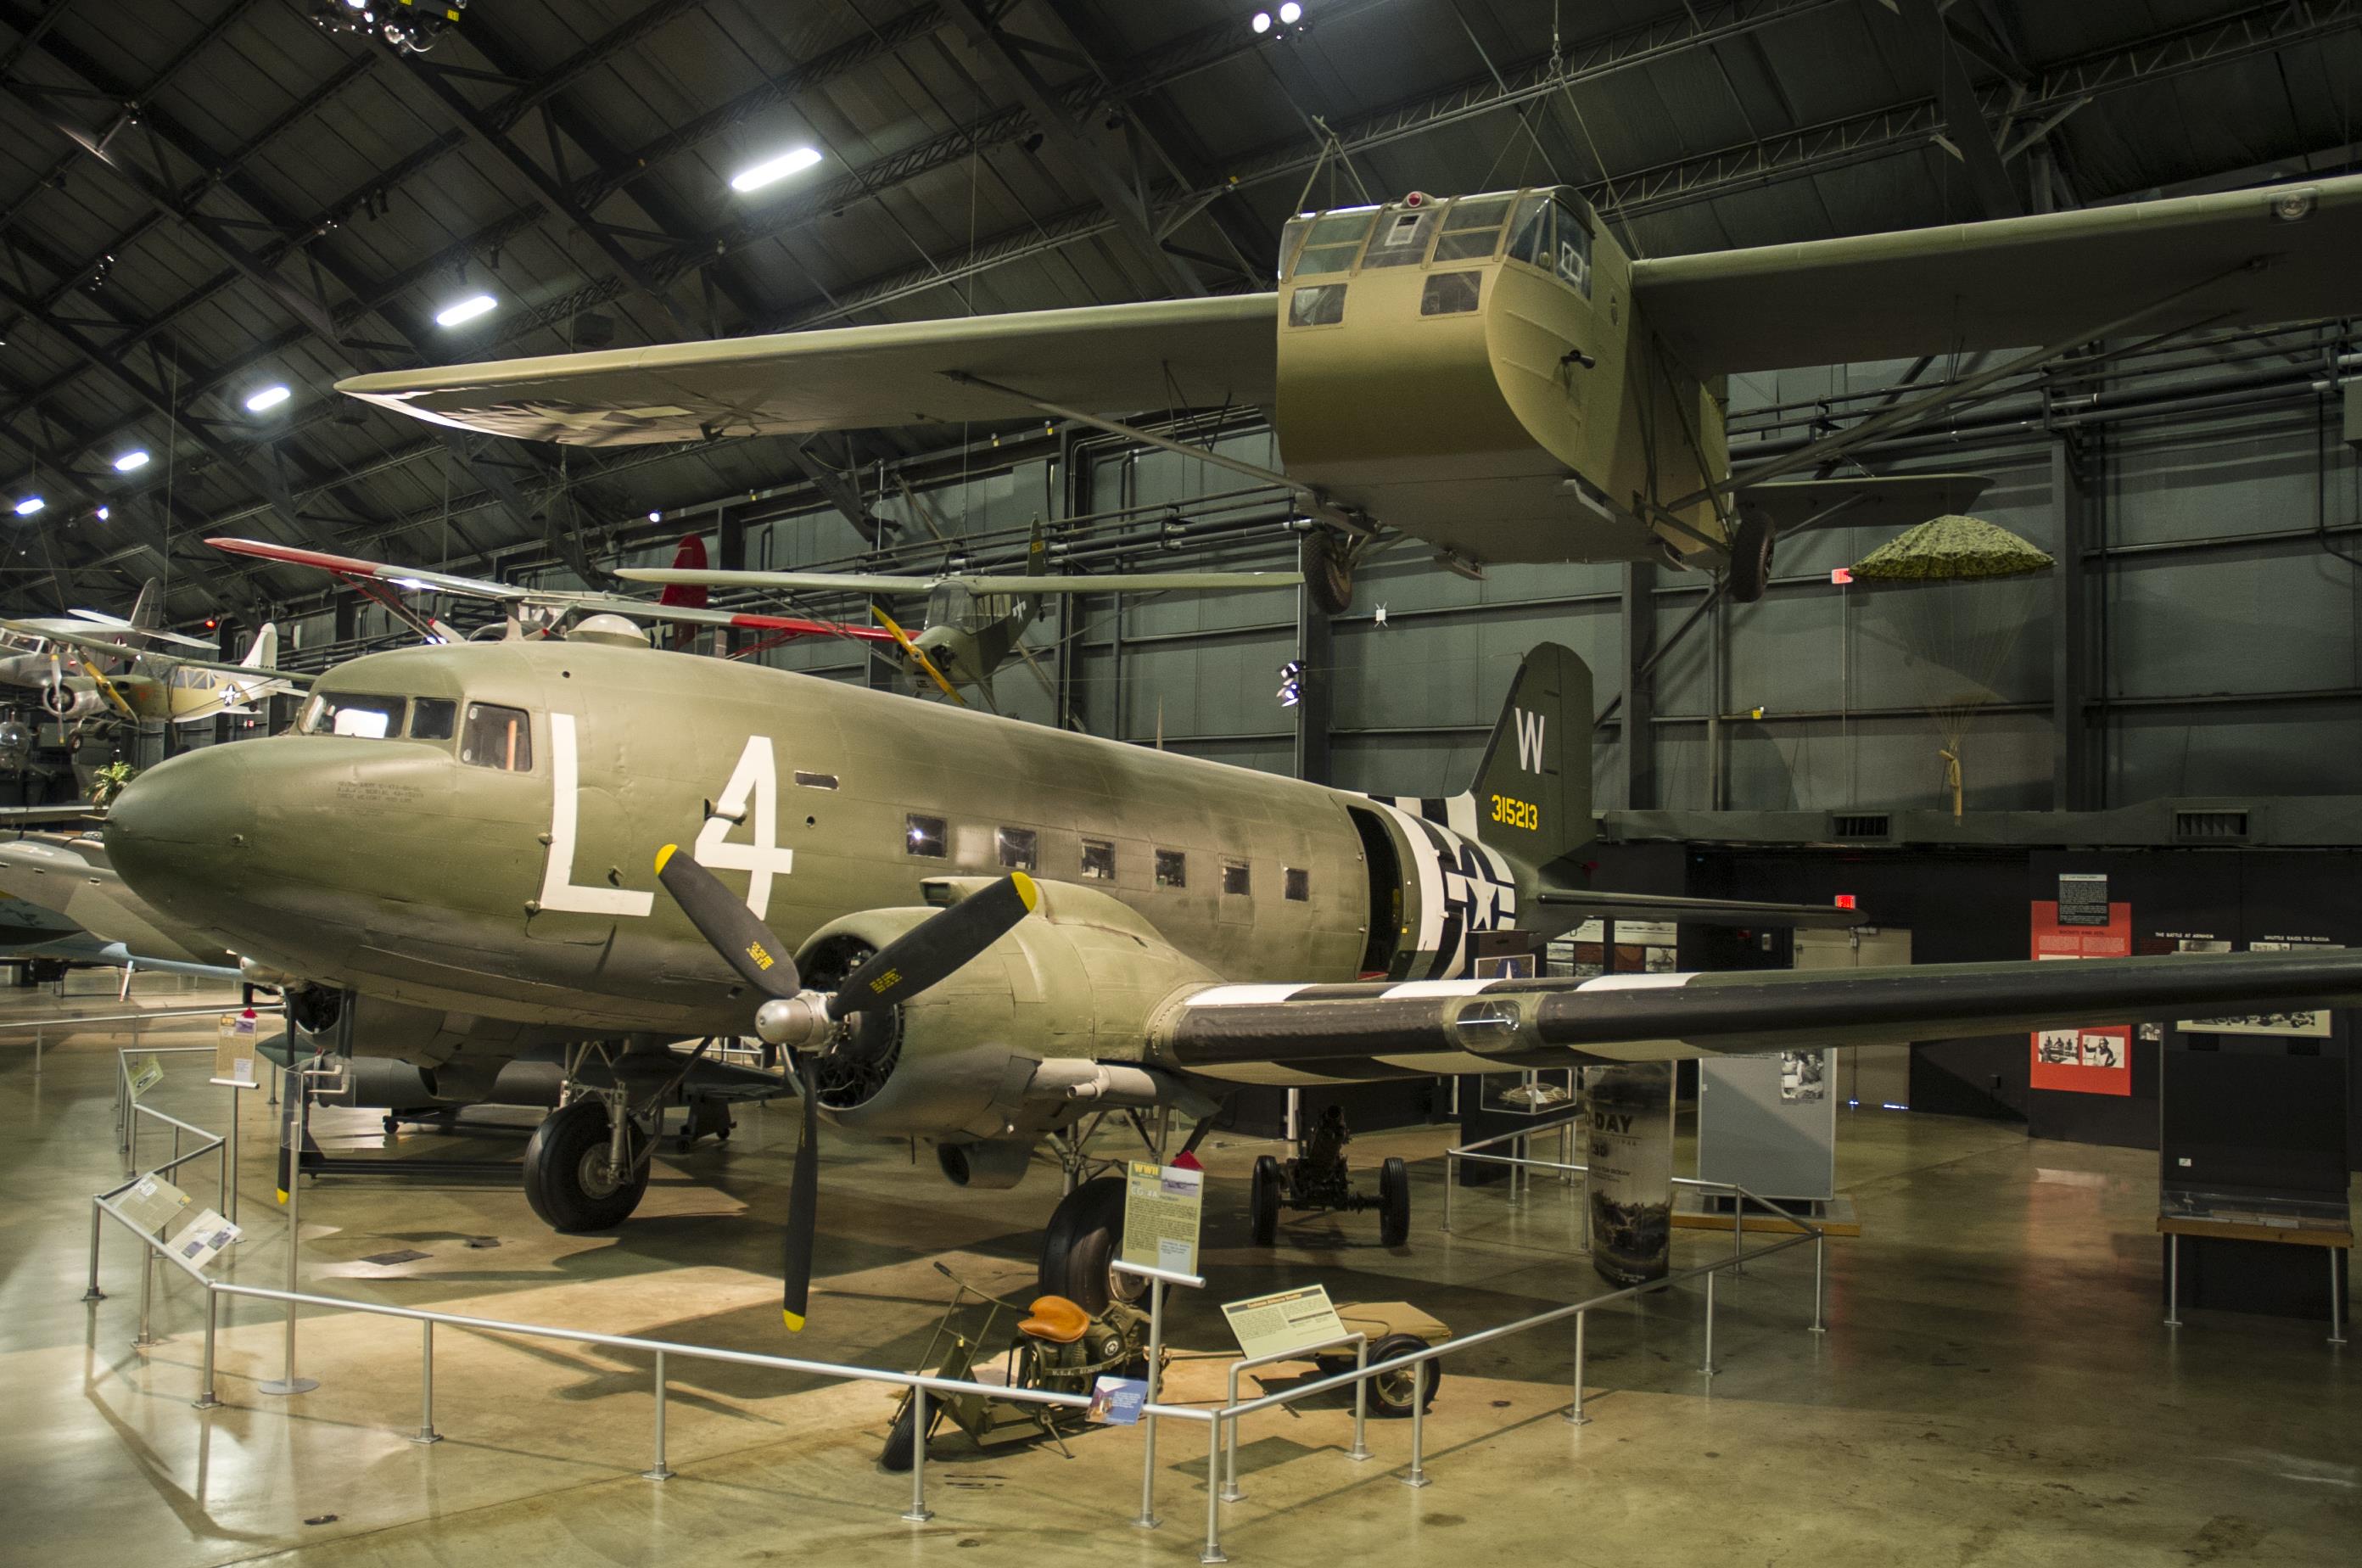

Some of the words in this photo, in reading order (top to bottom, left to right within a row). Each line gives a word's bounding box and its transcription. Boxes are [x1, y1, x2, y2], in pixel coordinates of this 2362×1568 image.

[1515, 708, 1545, 774] W
[540, 712, 654, 916] L
[695, 736, 793, 921] 4
[1491, 794, 1538, 831] 315213
[1133, 1163, 1159, 1176] WWII
